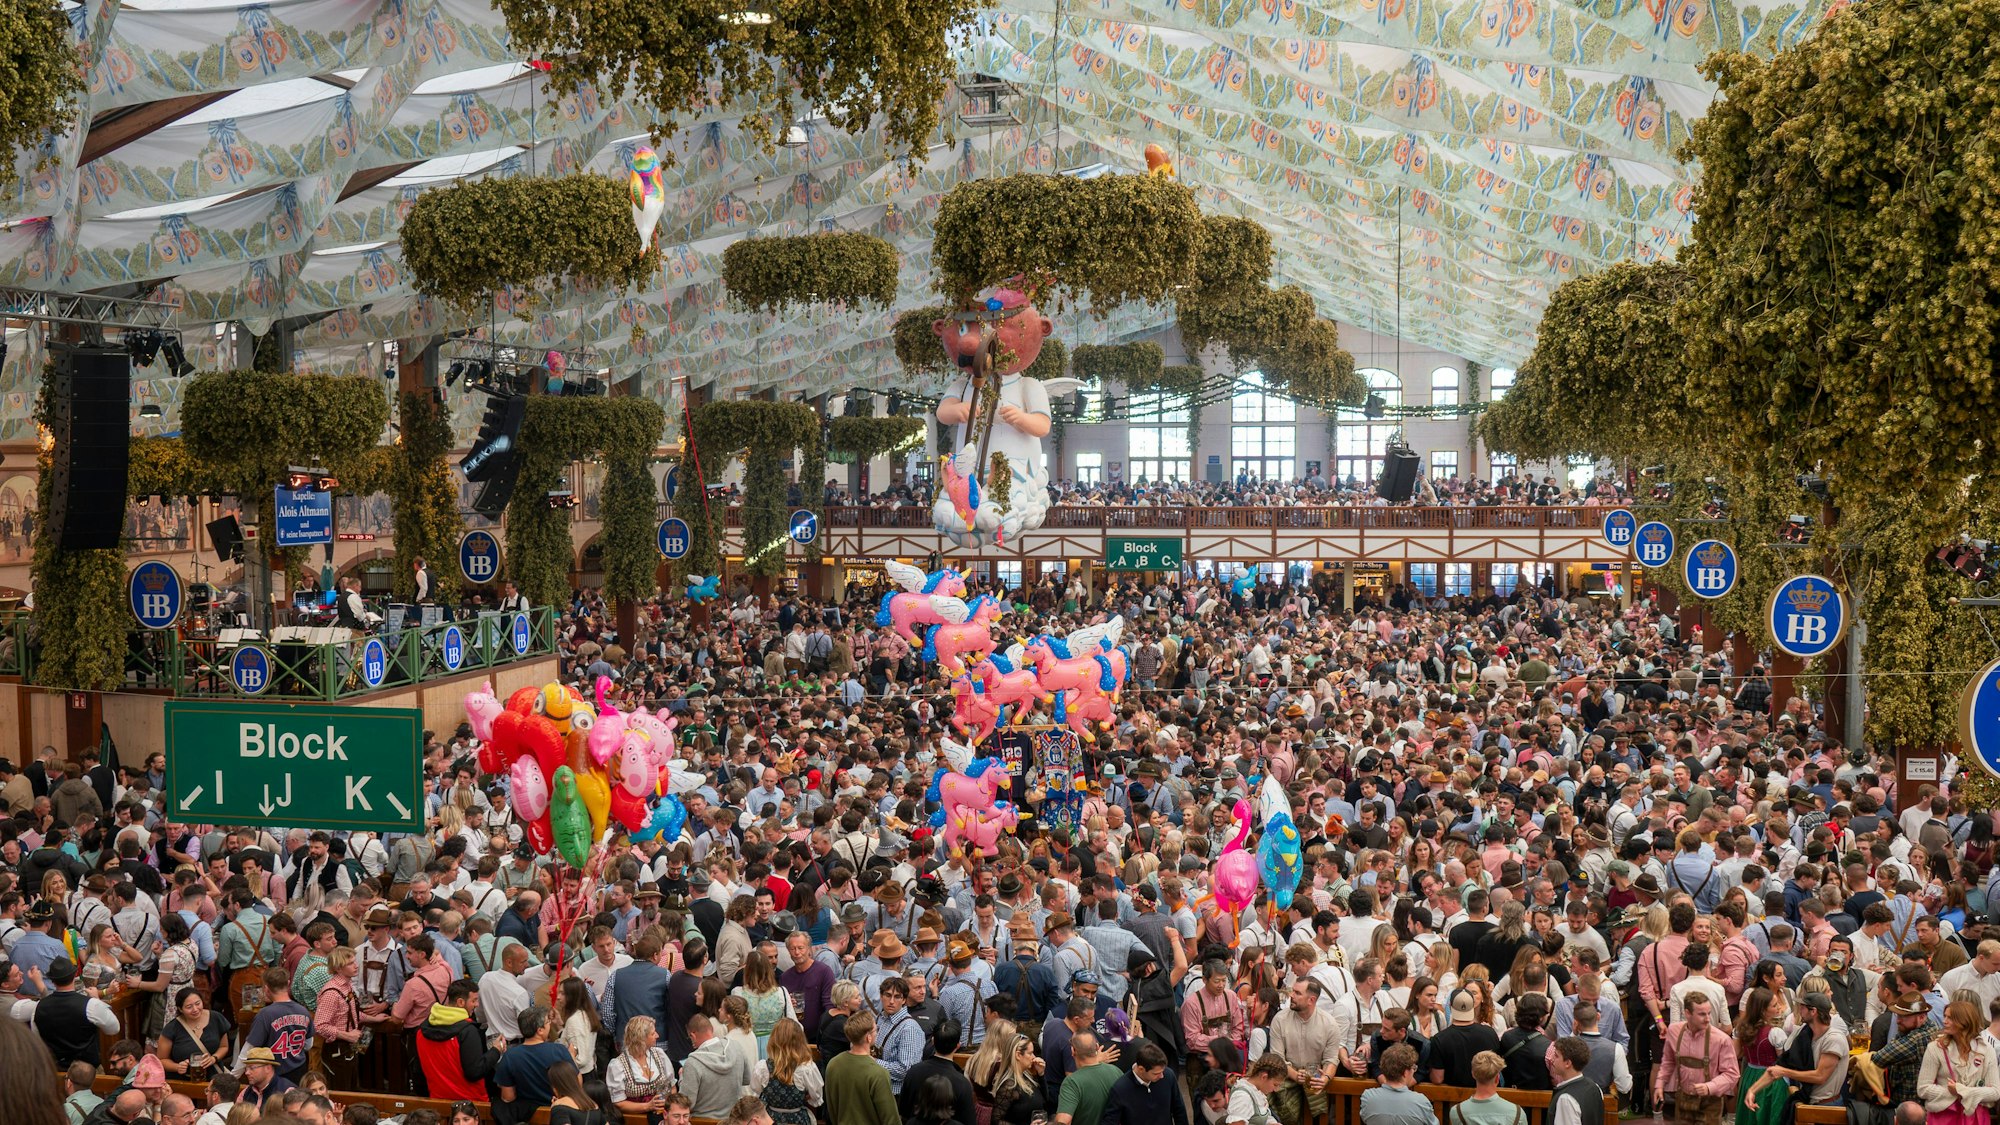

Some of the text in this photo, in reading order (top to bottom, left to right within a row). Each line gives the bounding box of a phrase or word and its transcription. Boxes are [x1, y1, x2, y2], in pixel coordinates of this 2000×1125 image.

[292, 490, 316, 503] Kapelle:
[278, 505, 329, 518] Alois Altmann
[300, 520, 310, 528] und
[795, 525, 812, 540] HB
[1610, 527, 1631, 542] HB
[664, 537, 684, 553] HB
[1123, 542, 1158, 553] Block
[1643, 543, 1667, 561] HB
[468, 555, 492, 576] HB
[1117, 555, 1171, 566] A B C
[1696, 567, 1727, 590] HB
[142, 593, 172, 619] HB
[1785, 613, 1827, 645] HB
[517, 632, 527, 650] HB
[448, 646, 460, 664] HB
[240, 668, 262, 687] HB
[368, 661, 382, 681] HB
[239, 722, 349, 761] Block
[215, 769, 373, 811] I J K
[271, 1013, 310, 1032] WAKEFIELD
[271, 1029, 308, 1060] 49
